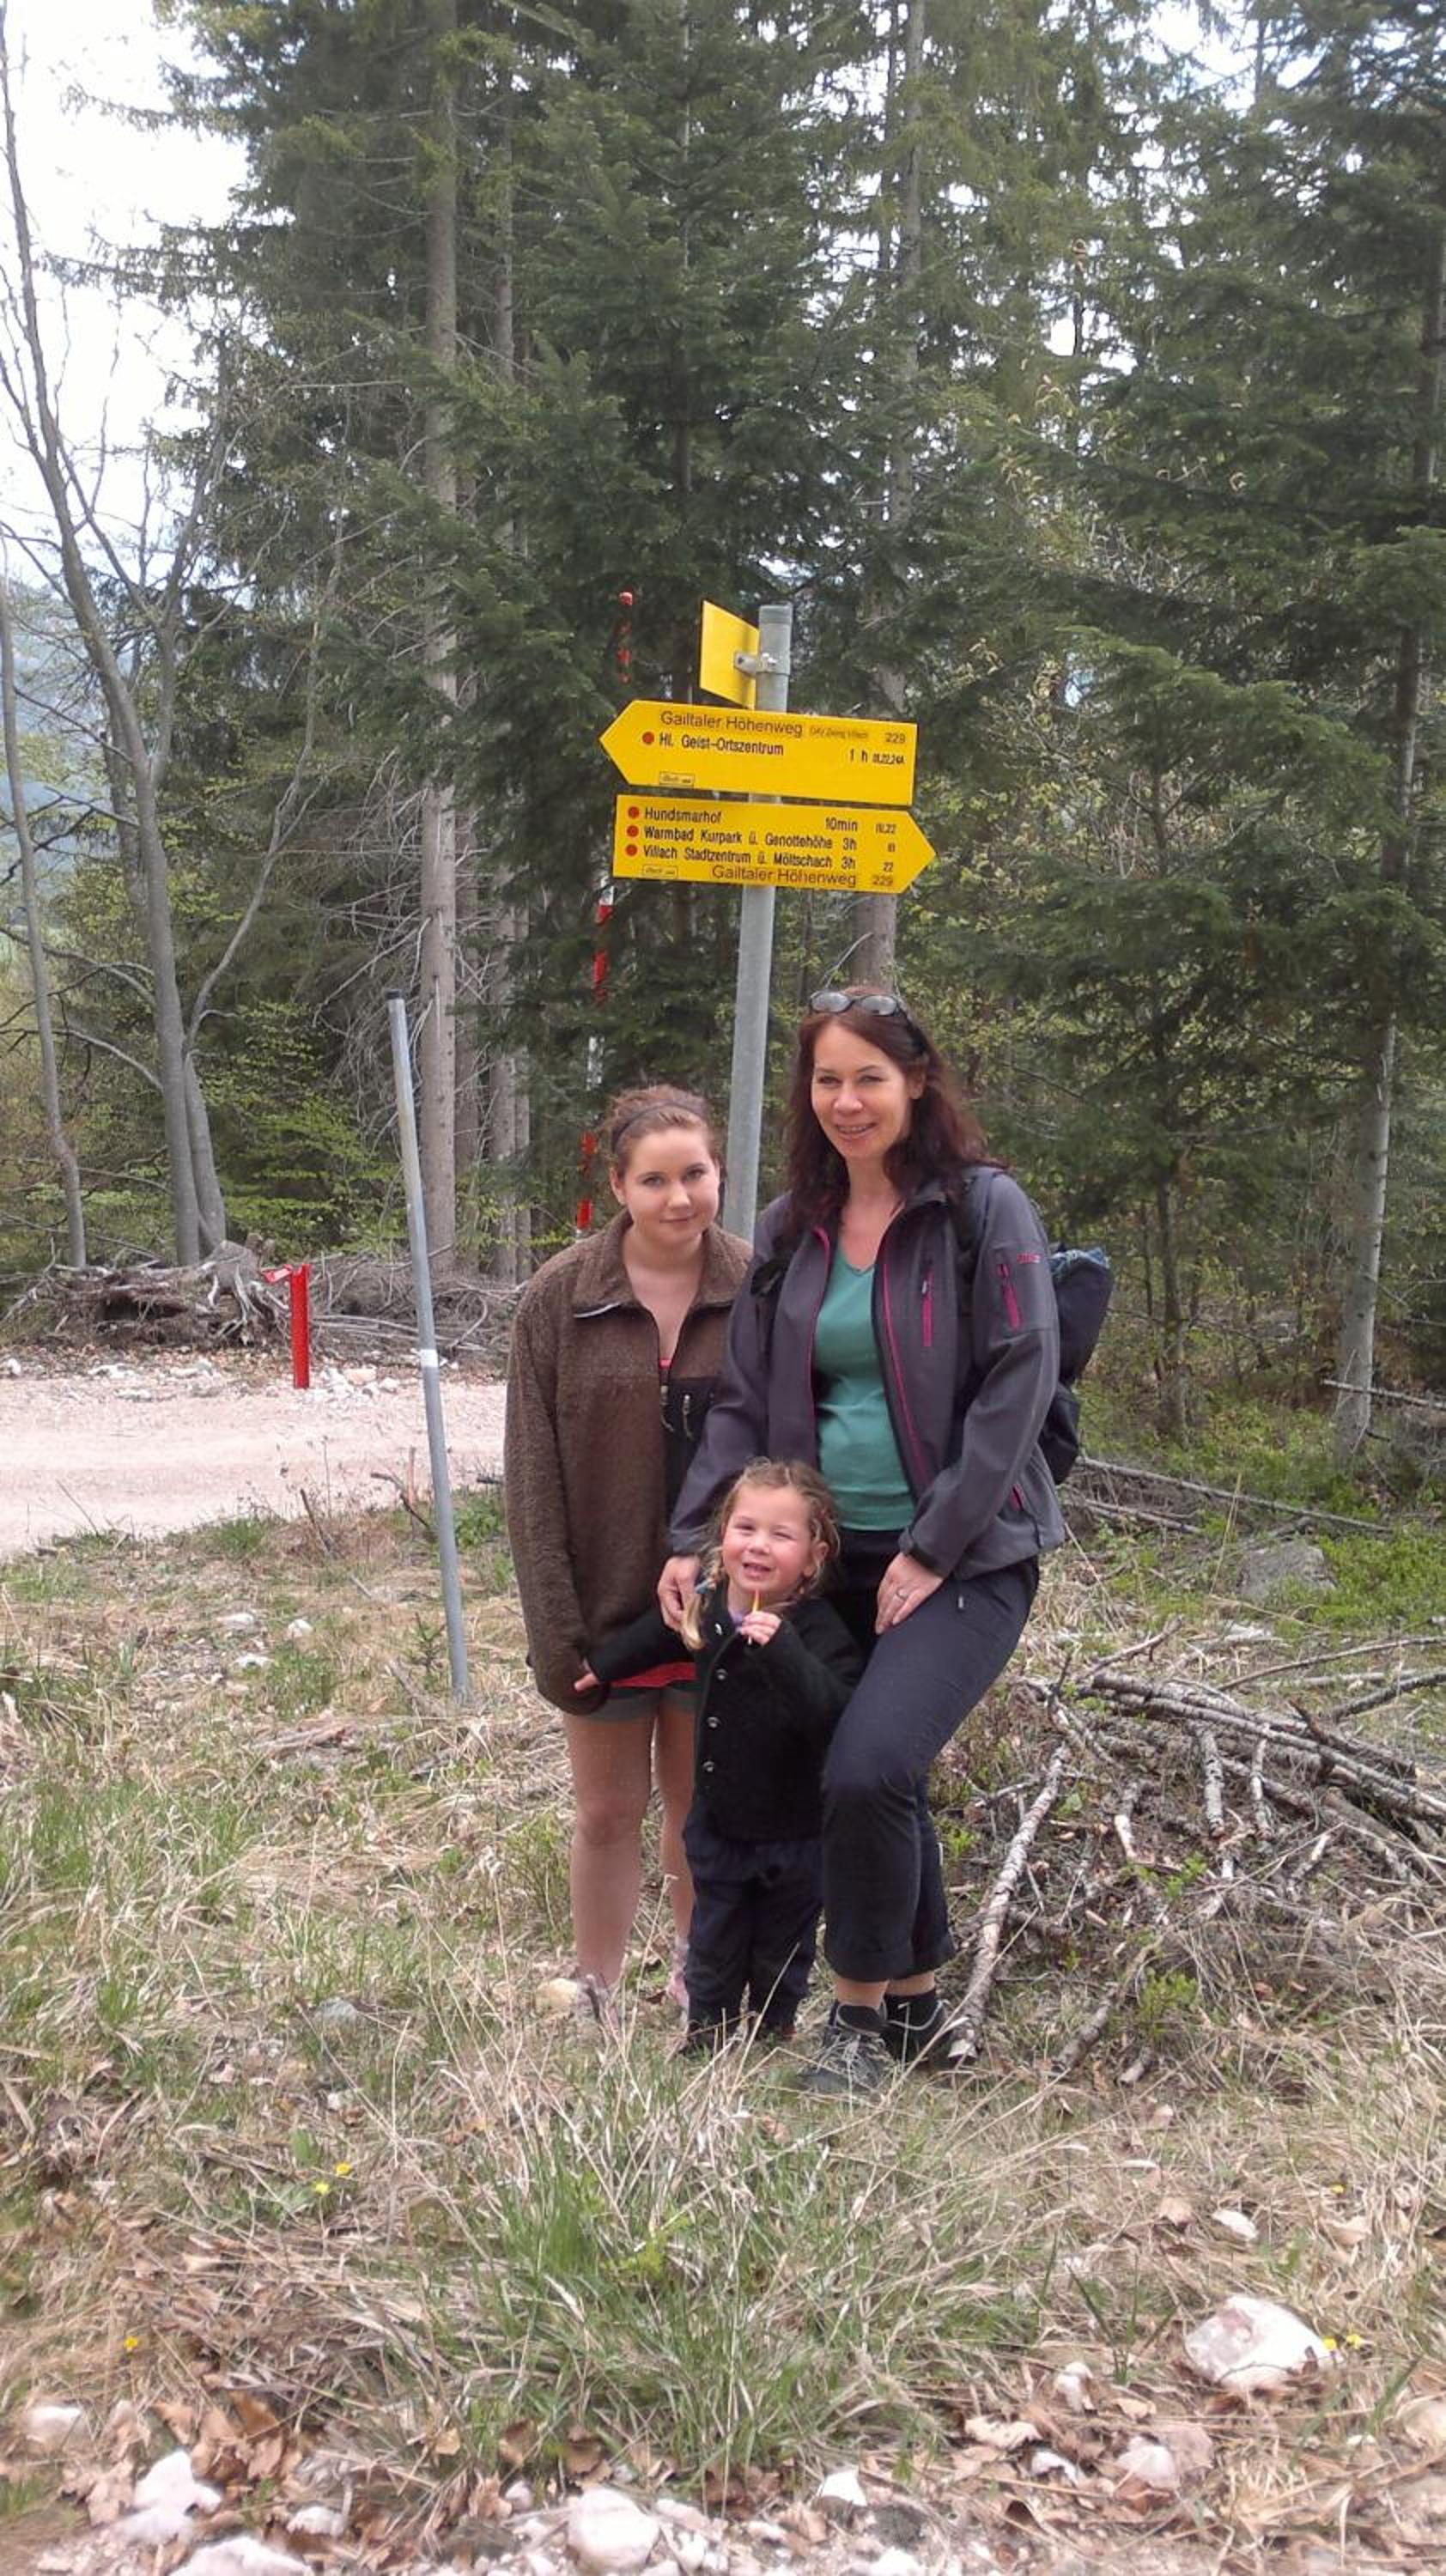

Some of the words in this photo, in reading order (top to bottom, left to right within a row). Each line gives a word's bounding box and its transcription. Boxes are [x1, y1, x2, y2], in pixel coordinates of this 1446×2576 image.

[661, 710, 721, 728] Gailtaler
[726, 716, 803, 738] Höhenweg
[885, 732, 906, 744] 229
[659, 732, 673, 746] Hl.
[681, 734, 784, 756] Geist-Ortszentrum
[861, 750, 868, 763] h
[645, 807, 722, 824] Hundsmarhof
[825, 817, 858, 832] 10min
[645, 826, 694, 842] Warmbad
[701, 829, 742, 845] Kurpark
[766, 833, 833, 849] Genottehöhe
[842, 837, 857, 851] 3h
[644, 844, 677, 859] Villach
[684, 847, 751, 864] Stadtzentrum
[774, 853, 832, 869] Möltschach
[841, 856, 856, 870] 3h
[713, 865, 774, 881] Gailtaler
[777, 869, 857, 888] Höhenweg
[872, 875, 894, 887] 229
